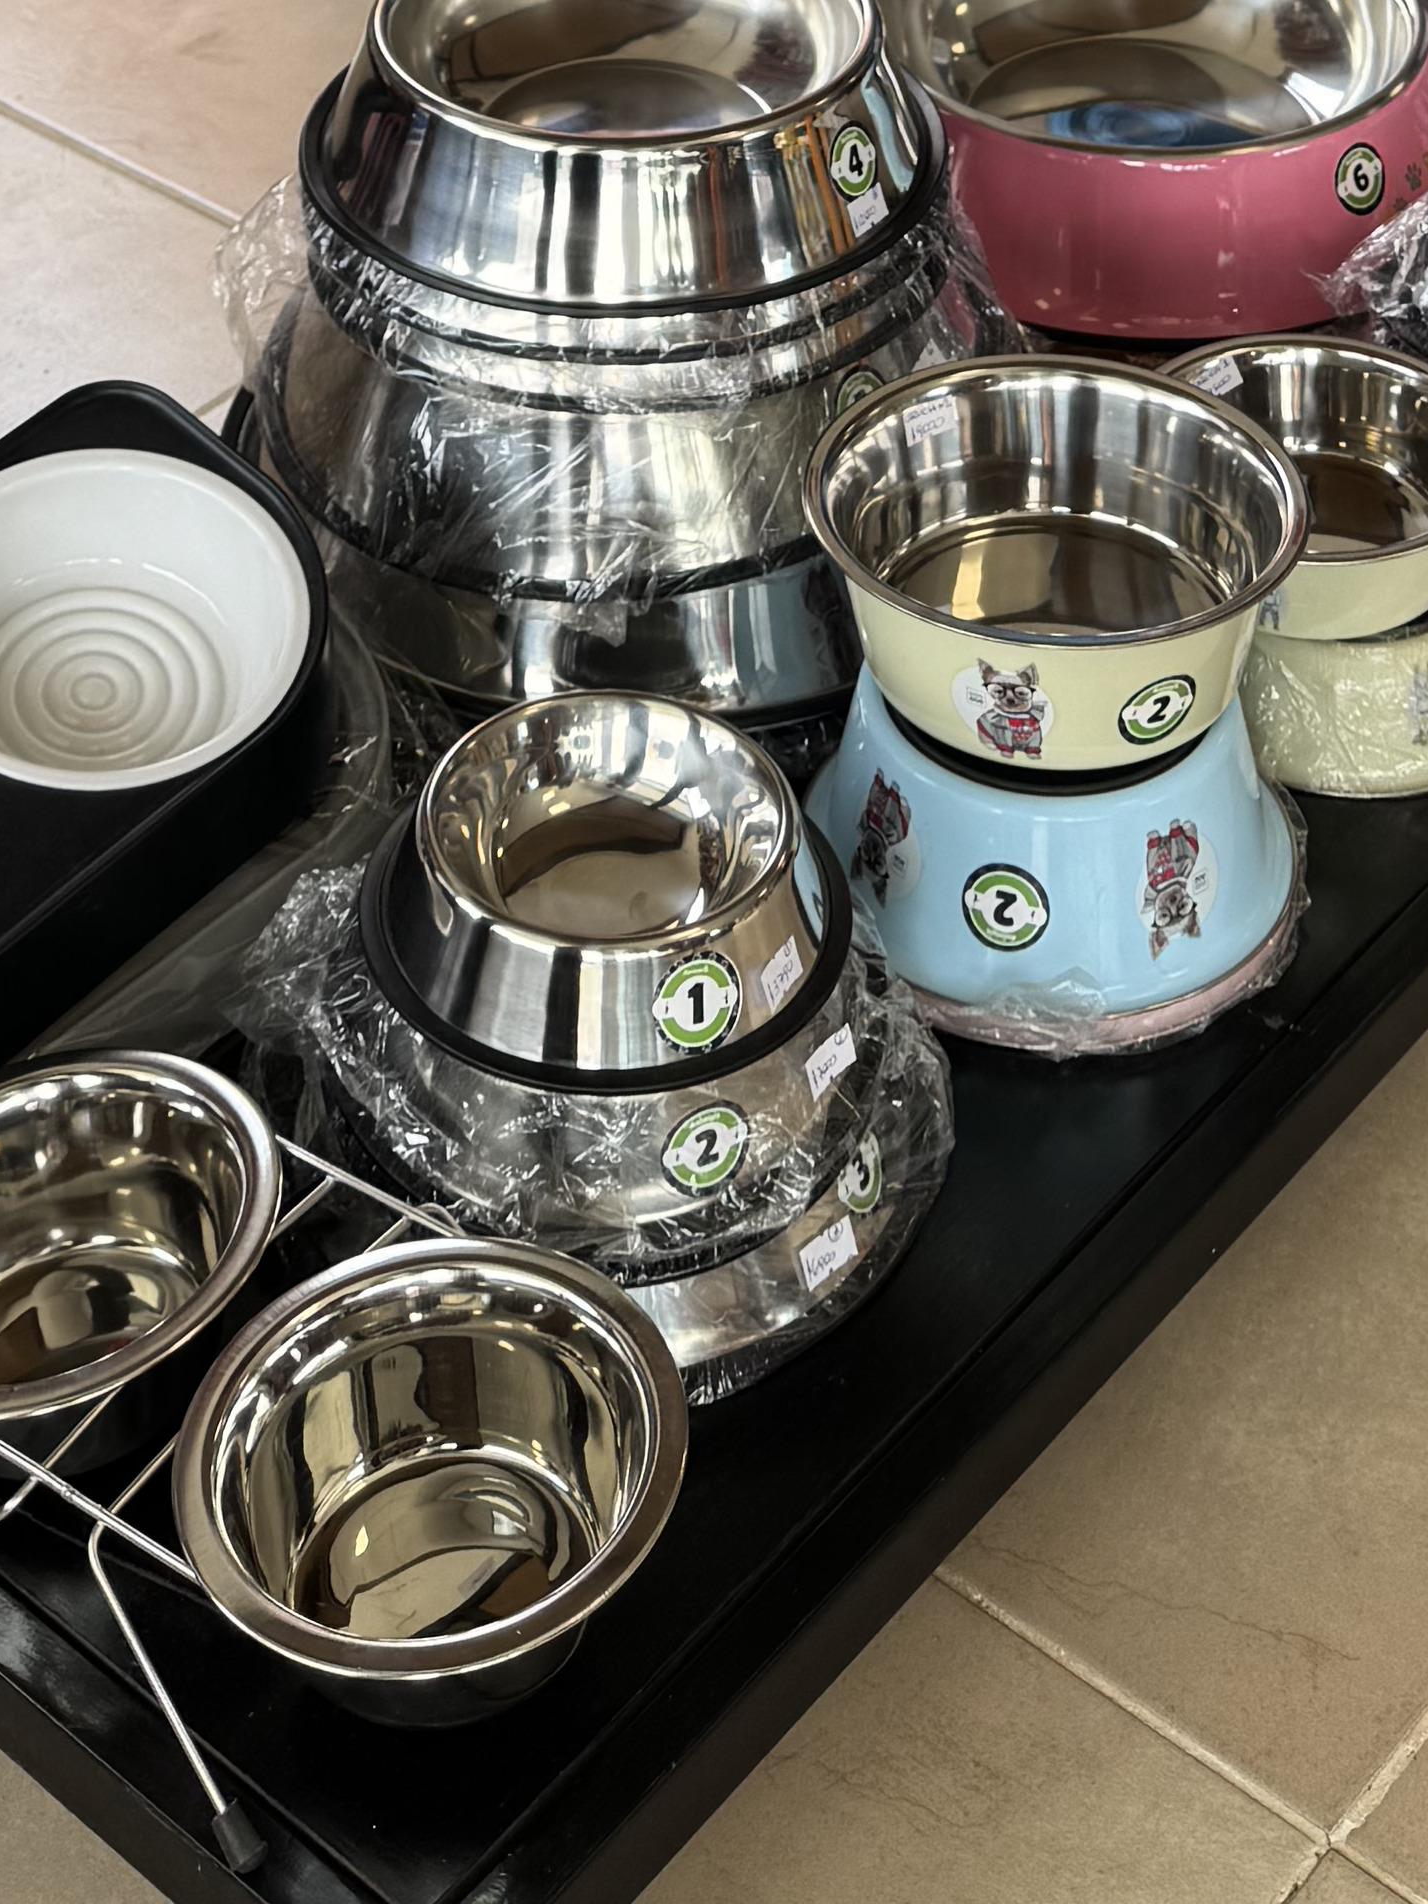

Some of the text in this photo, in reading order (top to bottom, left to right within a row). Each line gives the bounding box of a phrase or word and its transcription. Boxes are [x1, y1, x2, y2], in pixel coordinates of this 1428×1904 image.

[849, 142, 864, 177] 4
[1353, 162, 1370, 192] 6
[1146, 694, 1172, 724] 2
[993, 889, 1018, 927] 2
[687, 981, 705, 1025] 1
[695, 1128, 720, 1168] 2
[850, 1150, 871, 1192] 3
